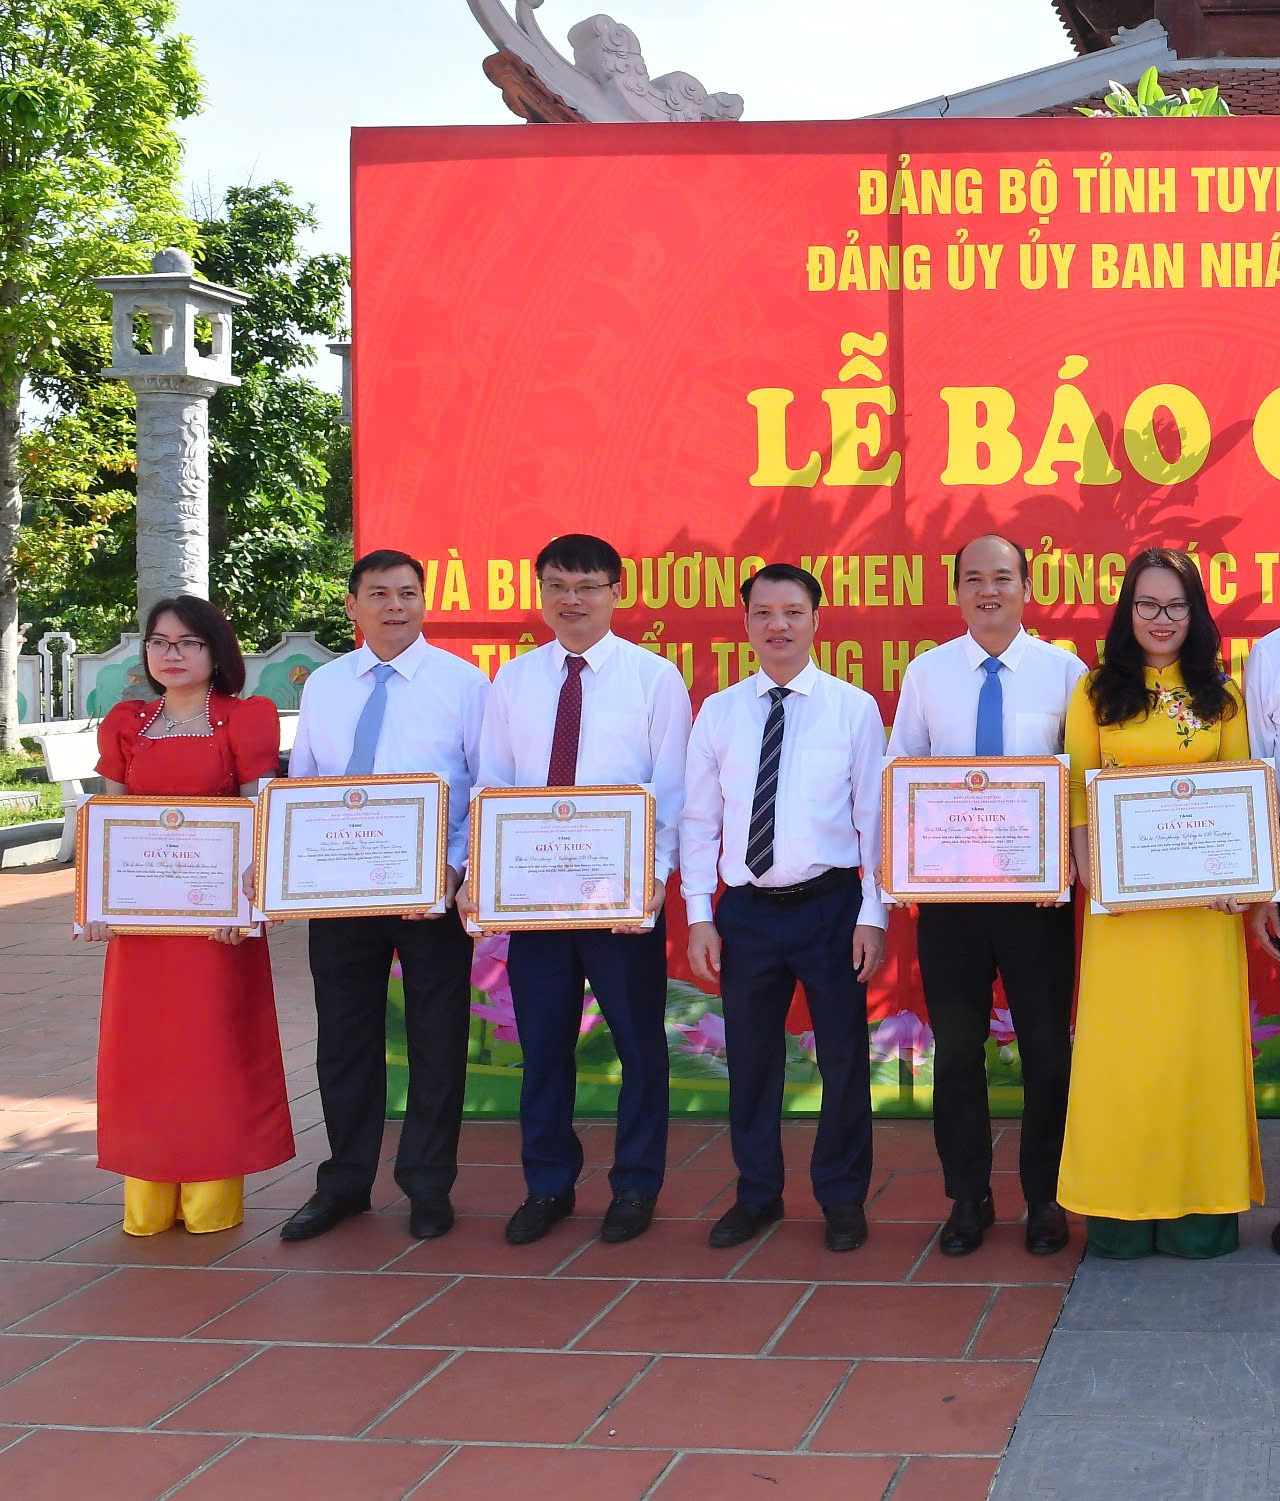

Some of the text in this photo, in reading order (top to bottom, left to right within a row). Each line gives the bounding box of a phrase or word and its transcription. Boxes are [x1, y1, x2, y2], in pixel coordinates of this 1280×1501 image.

[858, 154, 983, 215] ĐẢNG
[1000, 158, 1058, 224] BỘ
[1073, 152, 1176, 213] TỈNH
[807, 230, 931, 291] ĐẢNG
[947, 229, 1003, 289] ỦY
[1019, 228, 1076, 289] ỦY
[1091, 243, 1184, 289] BAN
[747, 331, 902, 488] LỄ
[940, 354, 1211, 486] BÁO
[801, 554, 924, 606] KHEN
[977, 814, 1006, 822] KHEN
[1186, 819, 1215, 829] KHEN
[355, 829, 384, 838] KHEN
[564, 842, 592, 850] KHEN
[172, 851, 200, 859] KHEN
